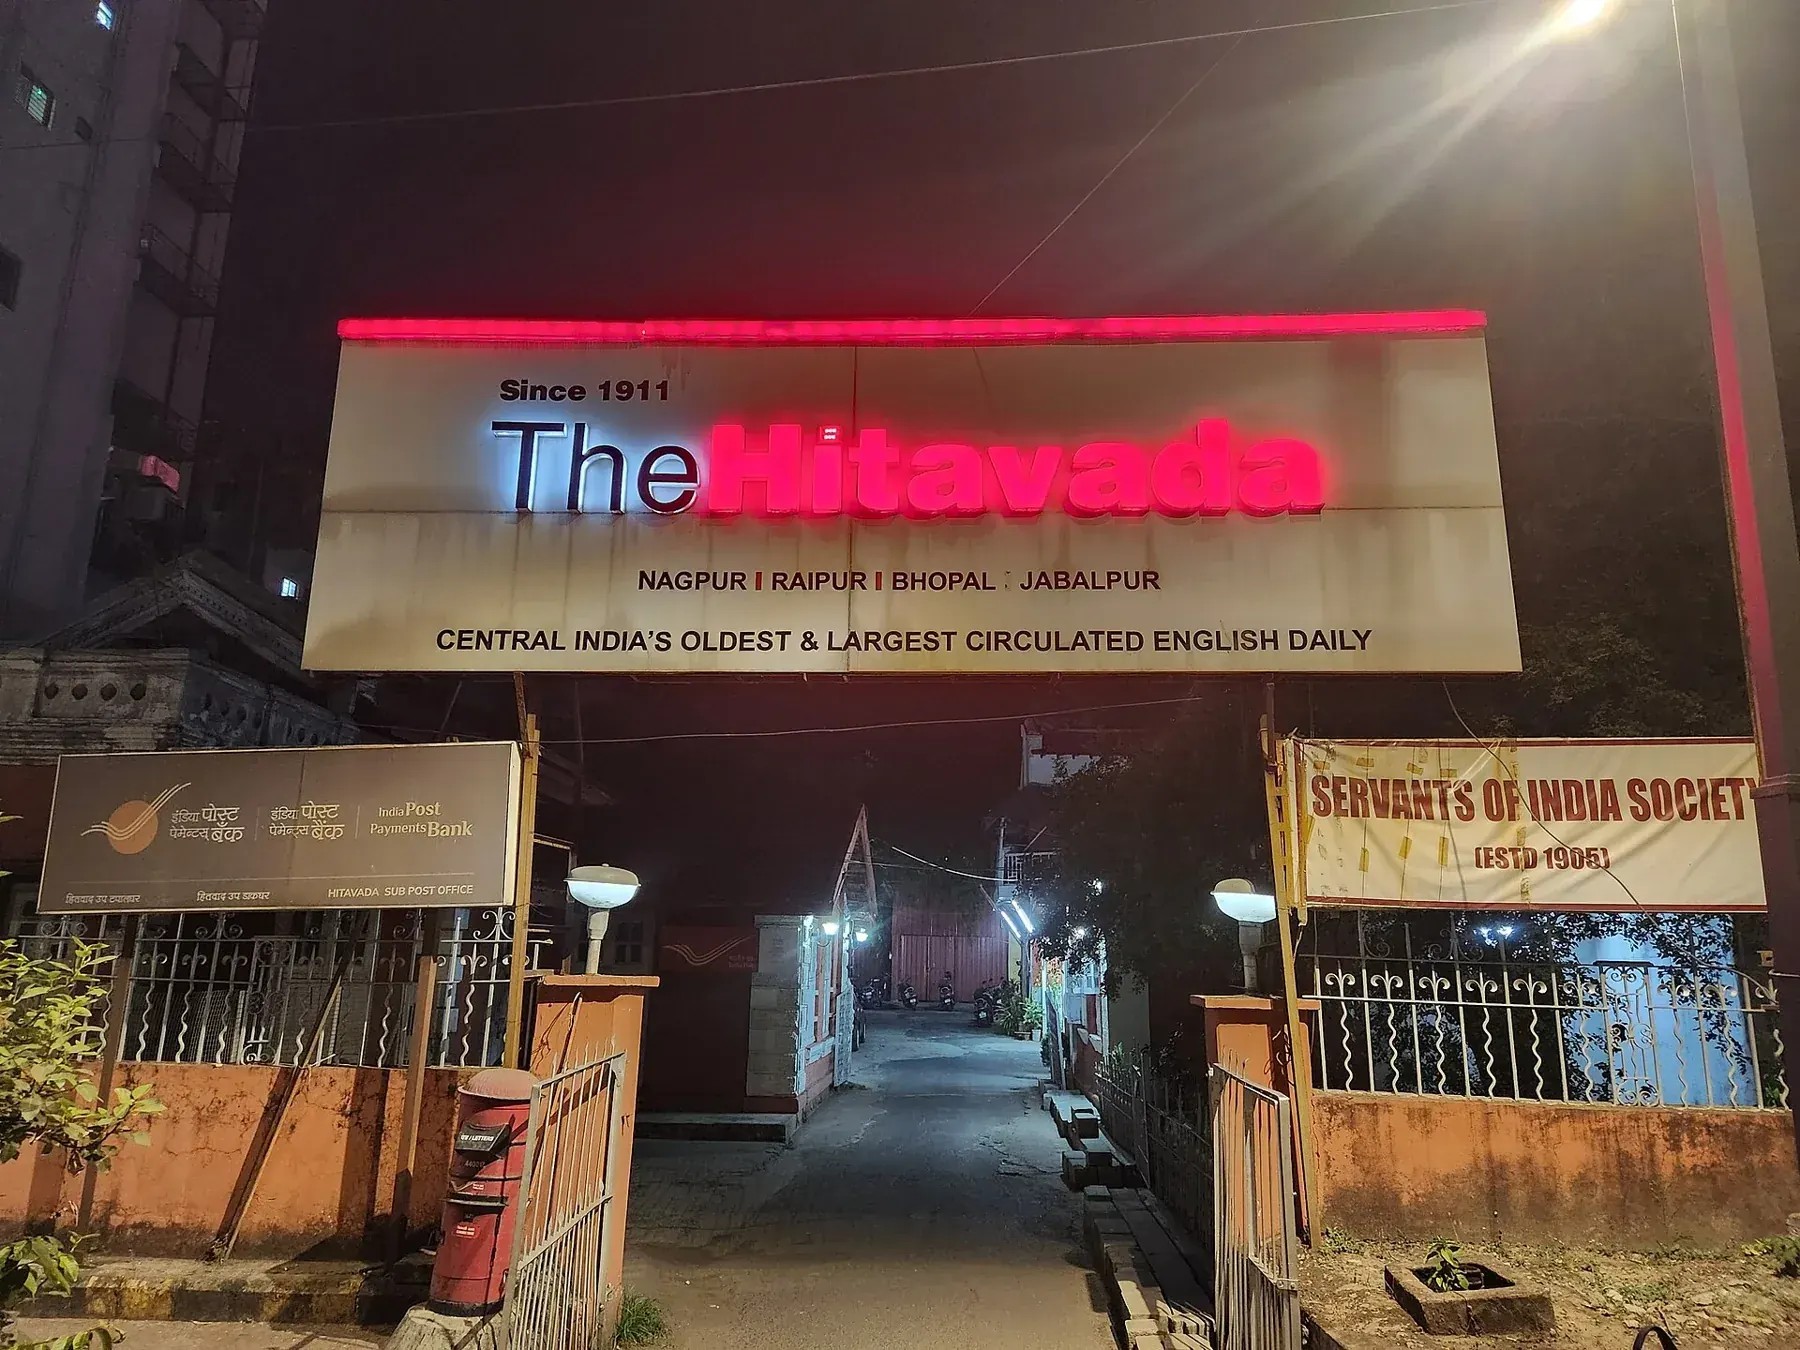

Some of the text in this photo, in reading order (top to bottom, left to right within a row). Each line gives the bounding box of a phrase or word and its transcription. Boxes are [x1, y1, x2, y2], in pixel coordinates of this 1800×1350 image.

[499, 379, 668, 401] Since 1911
[638, 571, 747, 591] NAGPUR
[772, 571, 867, 591] RAIPUR
[892, 571, 996, 591] BHOPAL
[1020, 571, 1161, 591] JABALPUR
[436, 629, 1373, 651] CENTRAL INDIA’S OLDEST & LARGEST CIRCULATED ENGLISH DAILY
[1311, 774, 1476, 822] SERVANTS
[1482, 778, 1520, 822] OF
[1526, 778, 1624, 822] INDIA
[171, 803, 240, 824] इंडिया पोस्ट
[271, 800, 340, 820] इंडिया पोस्ट
[378, 801, 441, 818] India Post
[311, 819, 345, 840] बैंक
[370, 820, 473, 837] Payments Bank
[1474, 846, 1611, 870] (ESTD 1905)
[328, 885, 473, 898] HITAVADA SUB POST OFFICE
